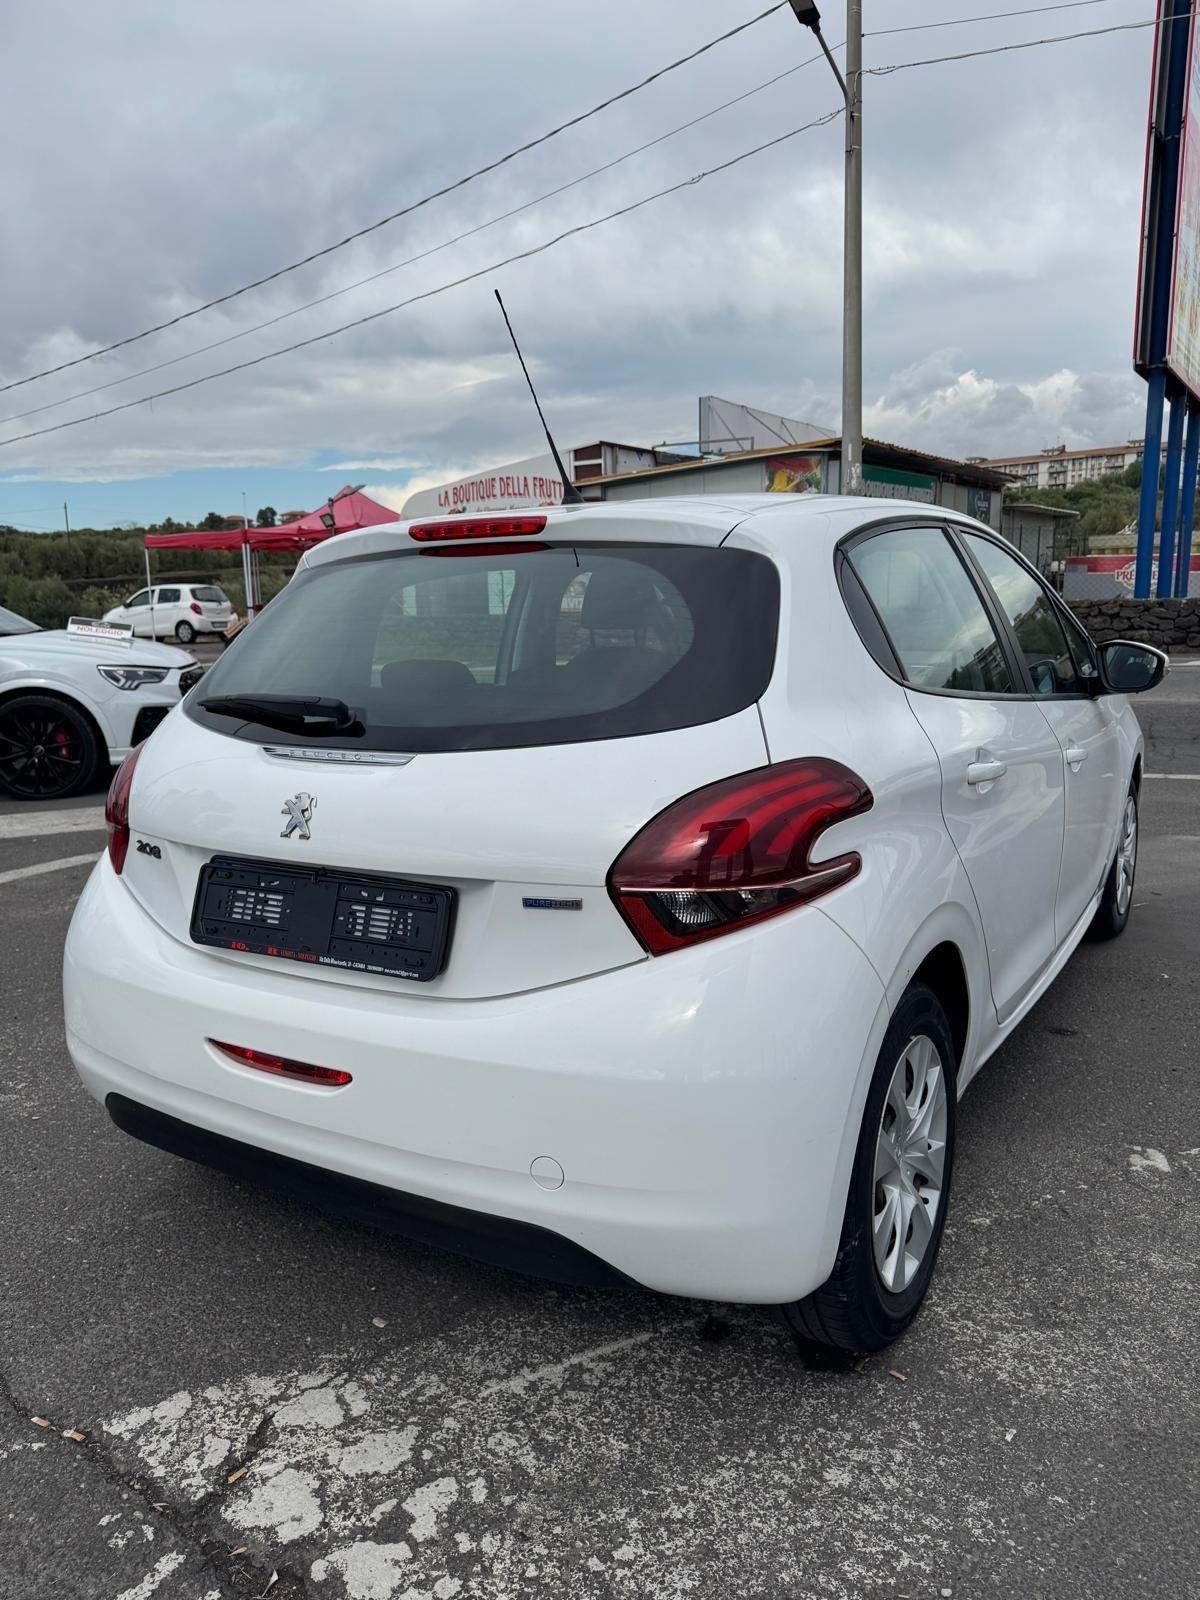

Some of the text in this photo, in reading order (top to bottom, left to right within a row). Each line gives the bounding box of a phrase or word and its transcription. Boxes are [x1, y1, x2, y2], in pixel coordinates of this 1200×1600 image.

[438, 491, 450, 507] LA
[453, 478, 497, 504] BOUTIQUE
[500, 476, 530, 497] DELLA
[77, 625, 123, 636] NOLEGGIO
[289, 749, 376, 761] PEUGEOT
[137, 840, 162, 859] 208
